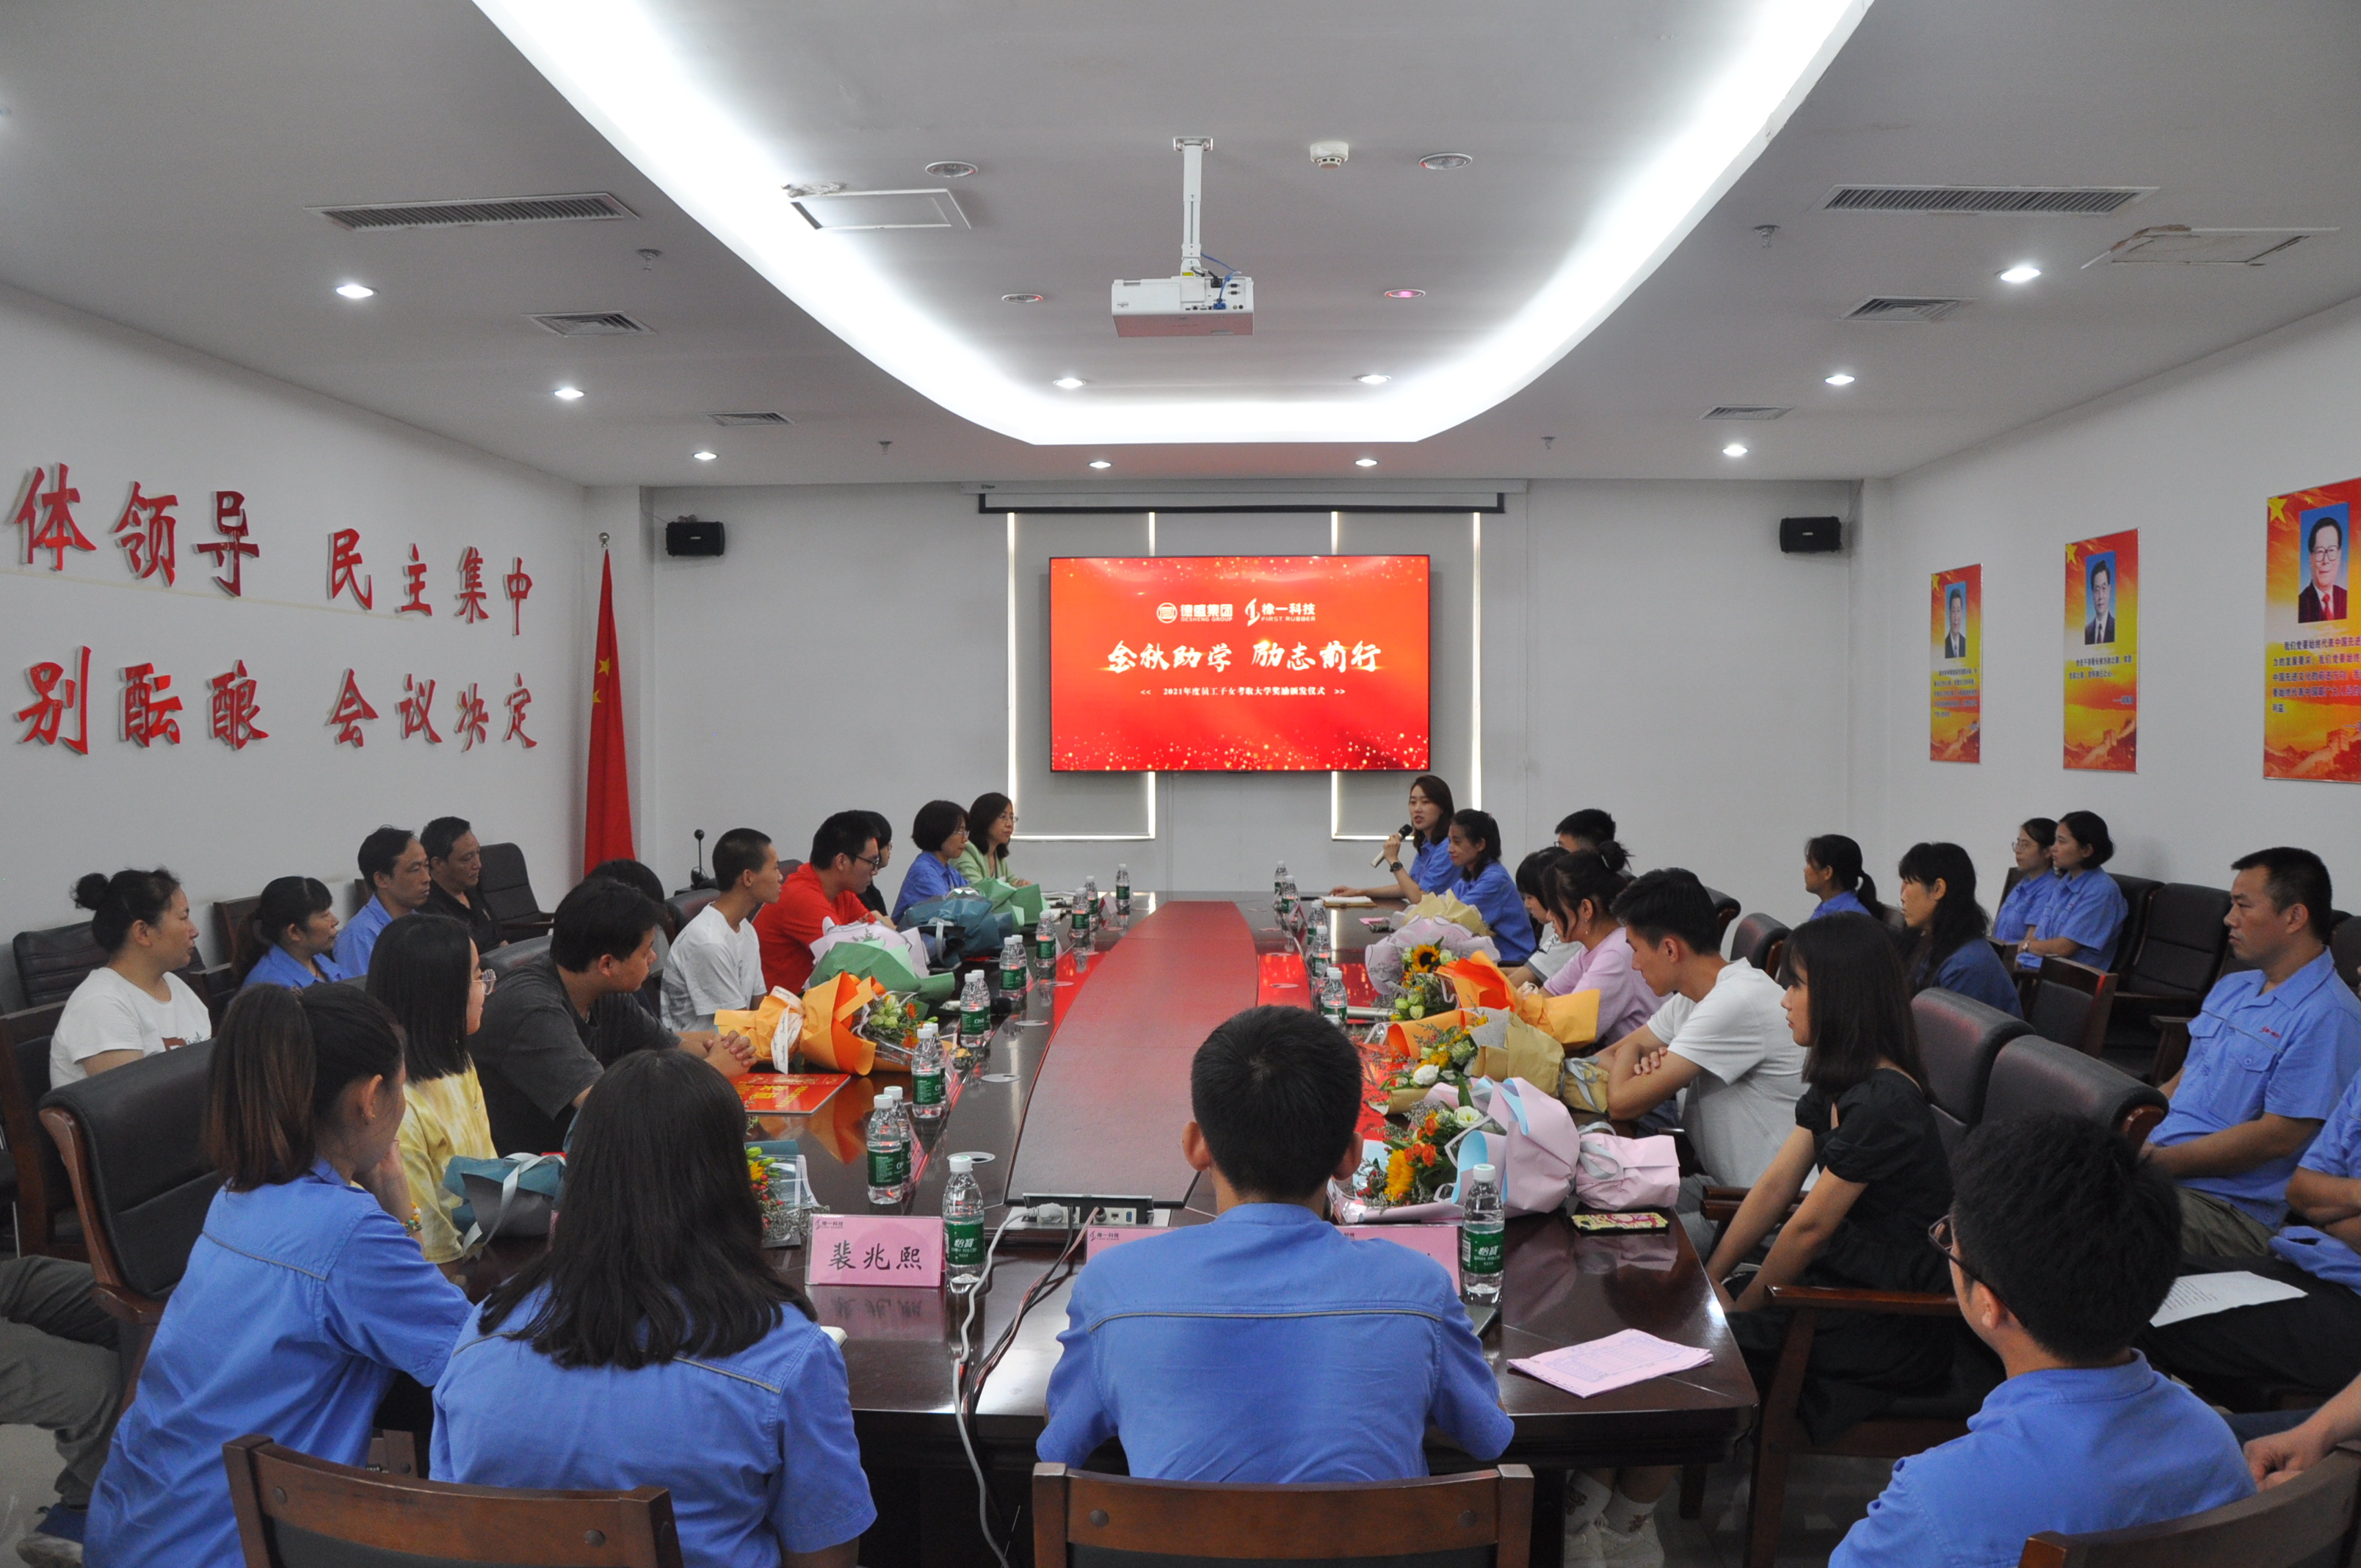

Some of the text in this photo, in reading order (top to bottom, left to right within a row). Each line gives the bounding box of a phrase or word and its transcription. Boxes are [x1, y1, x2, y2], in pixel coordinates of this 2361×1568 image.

[13, 462, 534, 636] 体领导 民主集中
[1180, 603, 1233, 617] 德盛集团
[1261, 603, 1316, 615] 橡一科技
[1106, 639, 1382, 674] 金秋助学 励志前行
[15, 645, 537, 755] 别酝酿 会议决定
[828, 1239, 922, 1271] 裴兆熙
